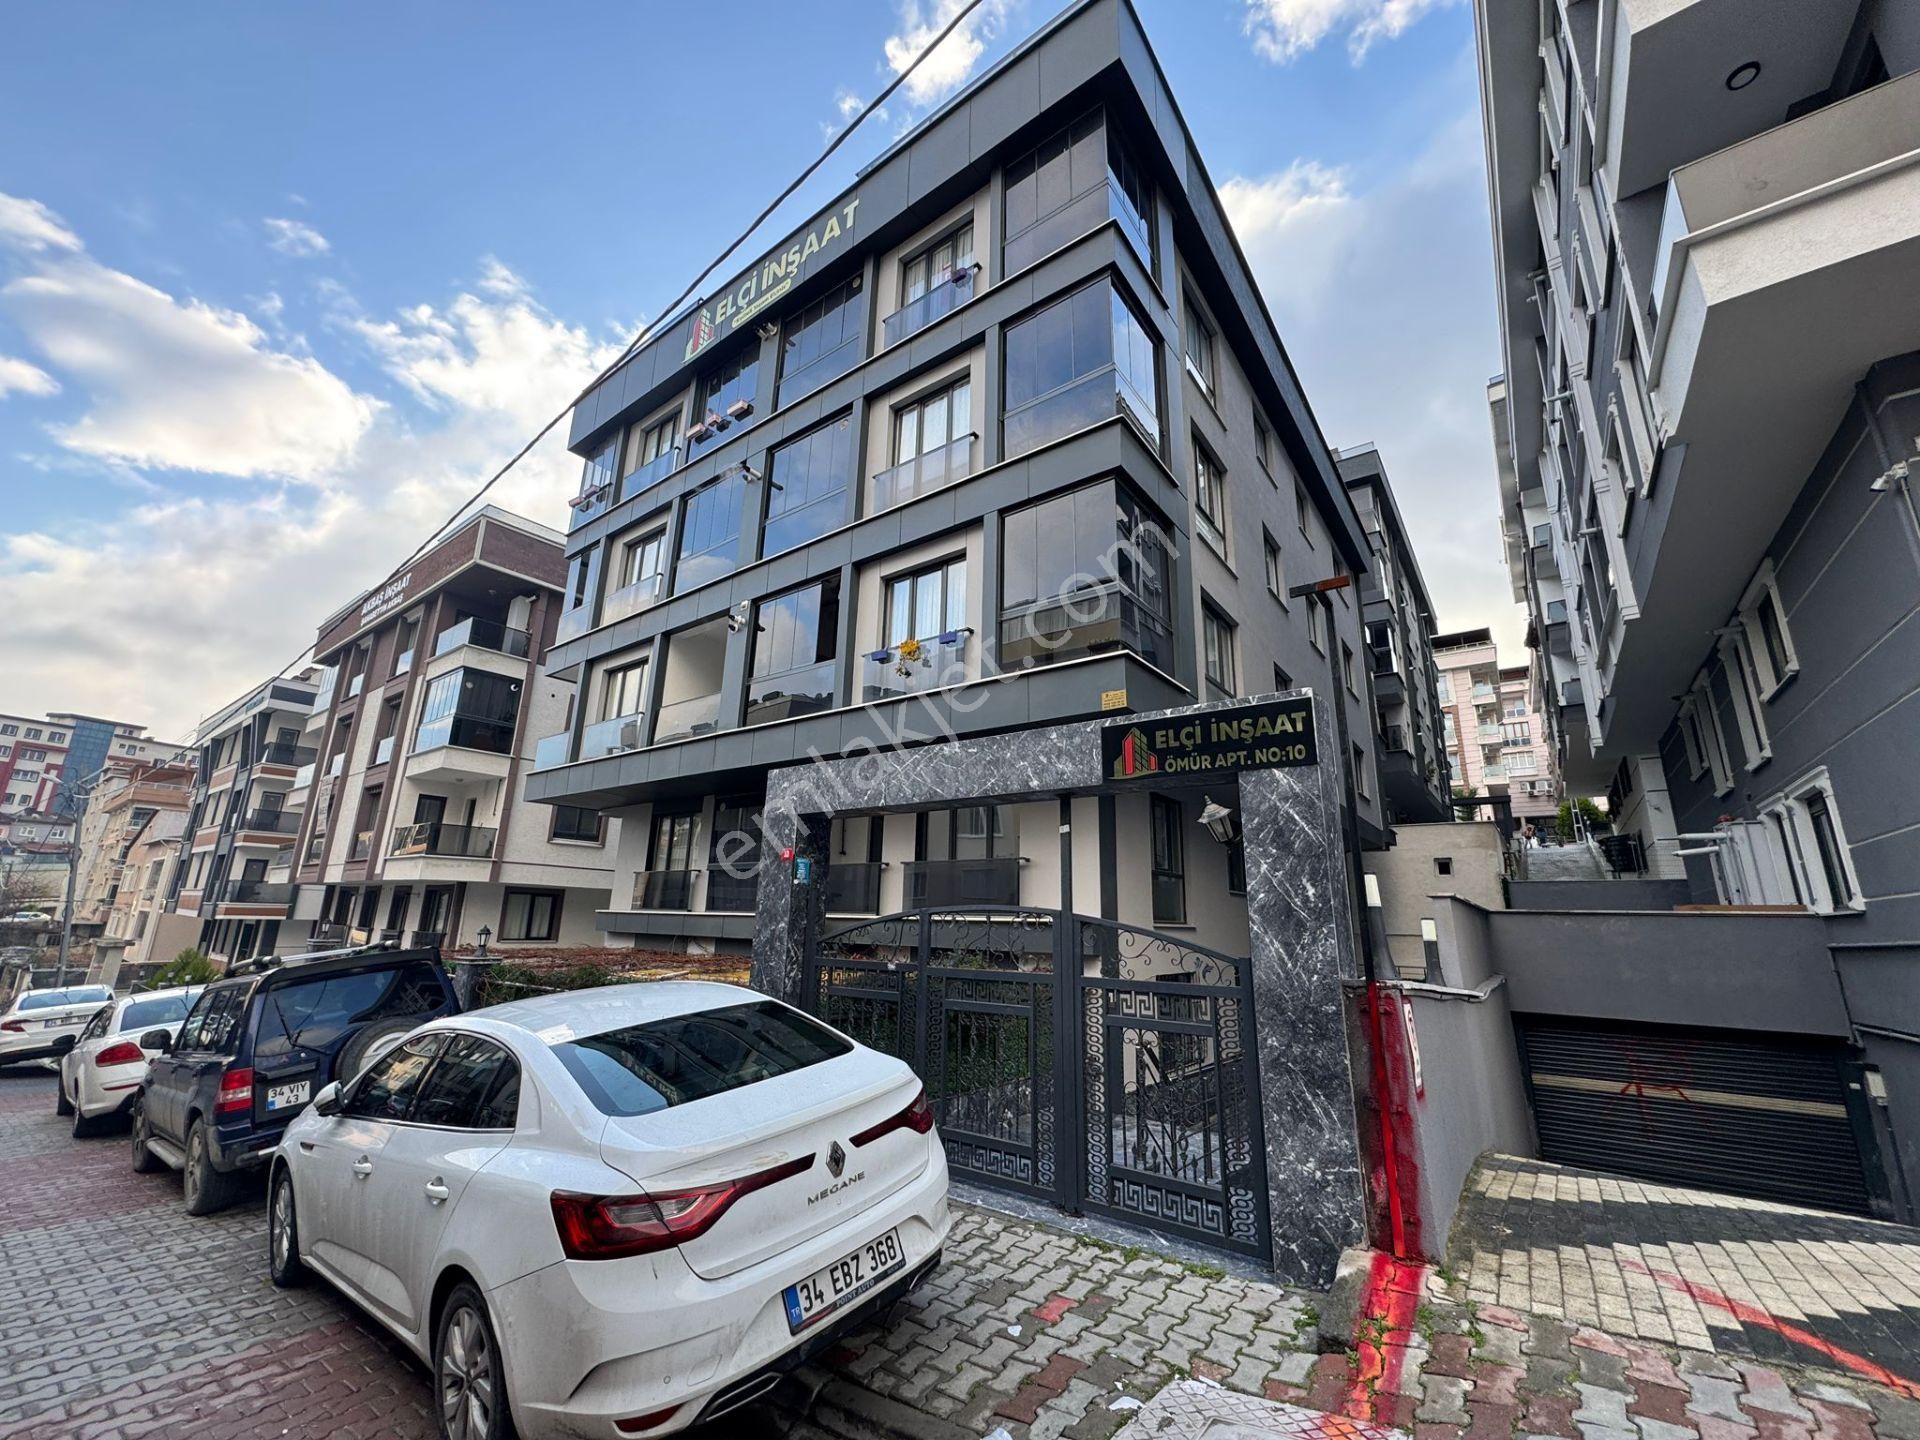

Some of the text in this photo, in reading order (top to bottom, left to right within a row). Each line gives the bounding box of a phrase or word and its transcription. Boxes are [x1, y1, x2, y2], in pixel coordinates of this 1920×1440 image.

[715, 271, 758, 326] ELÇİ
[761, 198, 860, 291] İNŞAAT
[1155, 711, 1306, 750] ELÇİ İNŞAAT
[1164, 744, 1306, 773] ÖMÜR APT. NO:10
[270, 1082, 307, 1099] 34 VIY
[285, 1094, 299, 1104] 43
[807, 1171, 866, 1206] MEGANE
[791, 1306, 801, 1318] TR
[800, 1278, 825, 1313] 34
[829, 1253, 865, 1296] EBZ
[866, 1234, 897, 1272] 368
